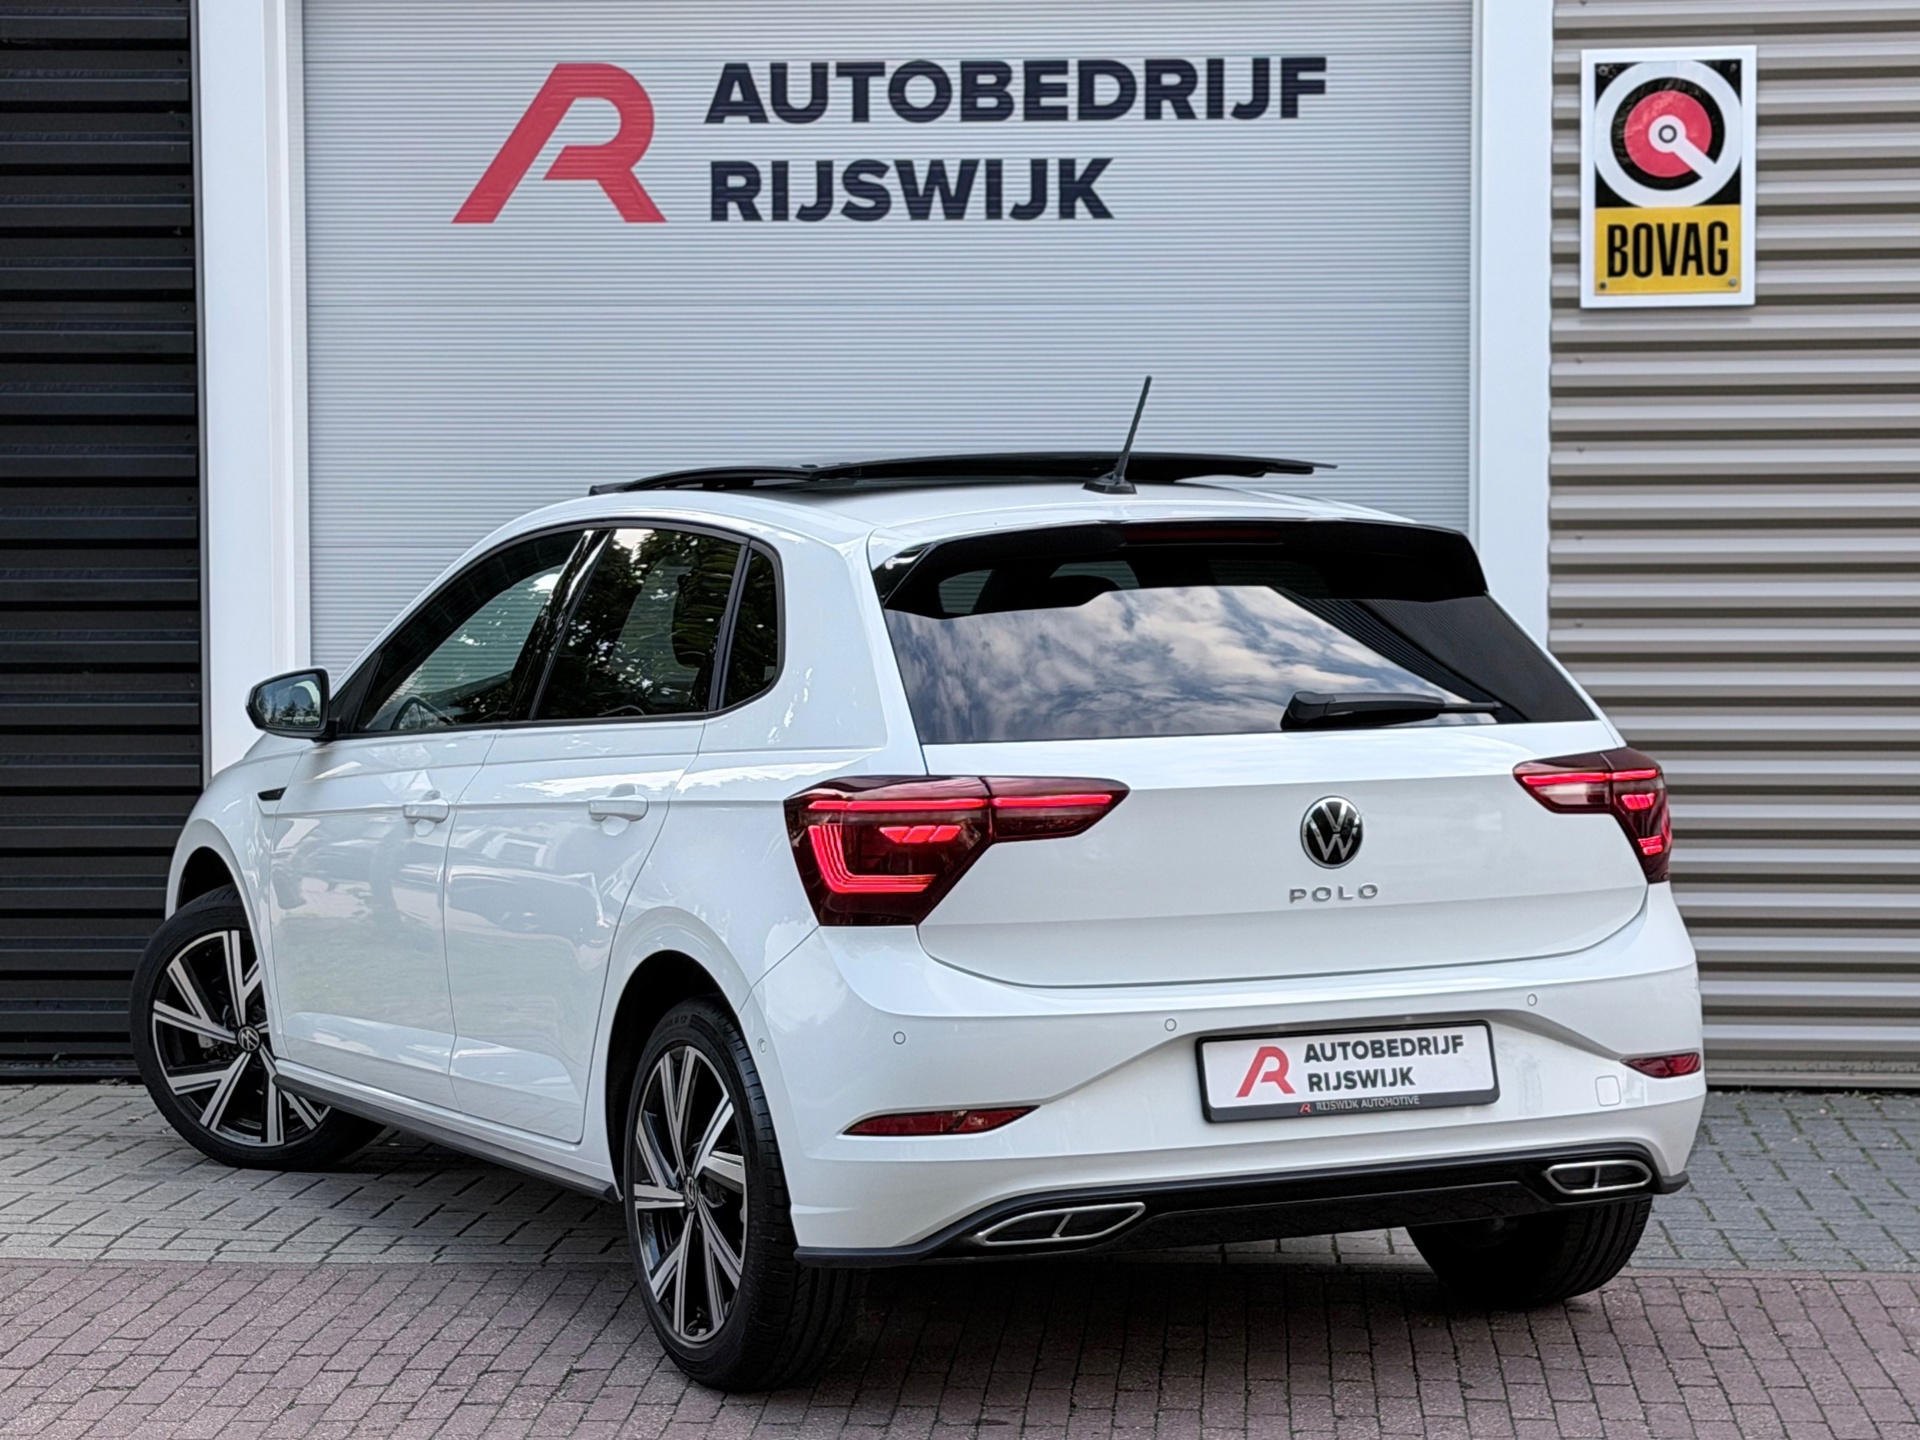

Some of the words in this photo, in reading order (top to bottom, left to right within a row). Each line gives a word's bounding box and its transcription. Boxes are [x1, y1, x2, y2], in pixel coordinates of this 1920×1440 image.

[704, 57, 1327, 124] AUTOBEDRIJF
[710, 157, 1114, 222] RIJSWIJK
[1607, 221, 1729, 278] BOVAG
[1289, 883, 1379, 904] POLO
[1304, 1034, 1464, 1063] AUTOBEDRIJF
[1308, 1067, 1416, 1092] RIJSWIJK
[1316, 1099, 1359, 1111] RIJSWIJK
[1361, 1095, 1420, 1108] AUTOMOTIVE
